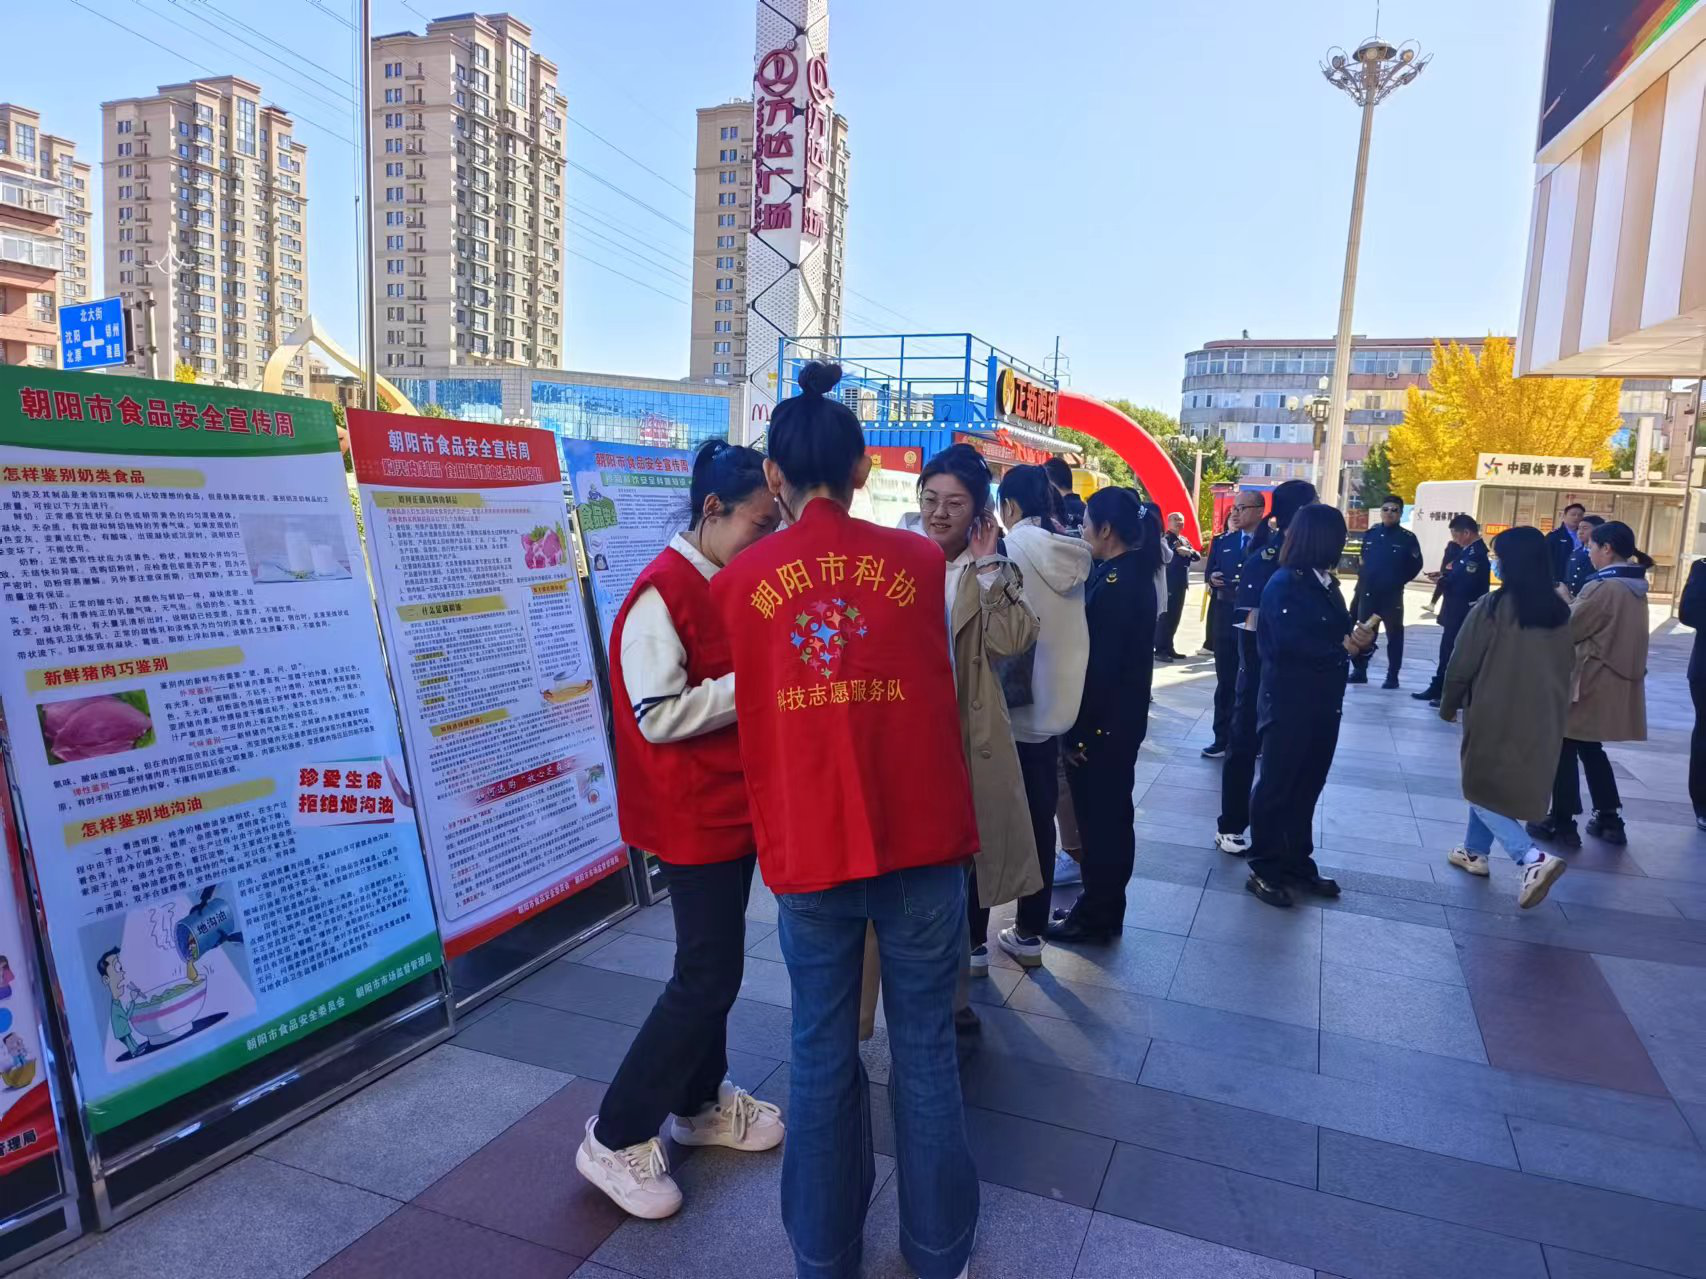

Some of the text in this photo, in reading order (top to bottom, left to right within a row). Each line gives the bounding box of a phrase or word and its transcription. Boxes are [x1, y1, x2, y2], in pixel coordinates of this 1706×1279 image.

[761, 98, 795, 230] 万达广场
[80, 307, 103, 322] 北大街
[65, 330, 81, 343] 沈阳
[20, 387, 296, 439] 朝阳市食品安全宣传周
[1015, 378, 1057, 426] 正新鸡排
[387, 429, 531, 460] 朝阳市食品安全宣传周
[3, 466, 145, 484] 怎样鉴别奶类食品
[382, 459, 443, 478] 购买肉制品
[595, 453, 689, 473] 朝阳市食品安全宣传周
[1507, 461, 1586, 478] 中国体育彩票
[750, 552, 917, 620] 朝阳市科协
[43, 657, 169, 687] 新鲜猪肉巧鉴别
[777, 678, 906, 713] 科技志愿服务队
[299, 767, 383, 790] 珍爱生命
[82, 797, 203, 838] 怎样鉴别地沟油
[298, 794, 395, 814] 拒绝地沟油
[518, 881, 570, 915] 朝阳市食品安全委员会
[197, 910, 228, 935] 地沟油
[246, 952, 433, 1052] 朝阳市食品安全委员会 朝阳市市场监督管理局
